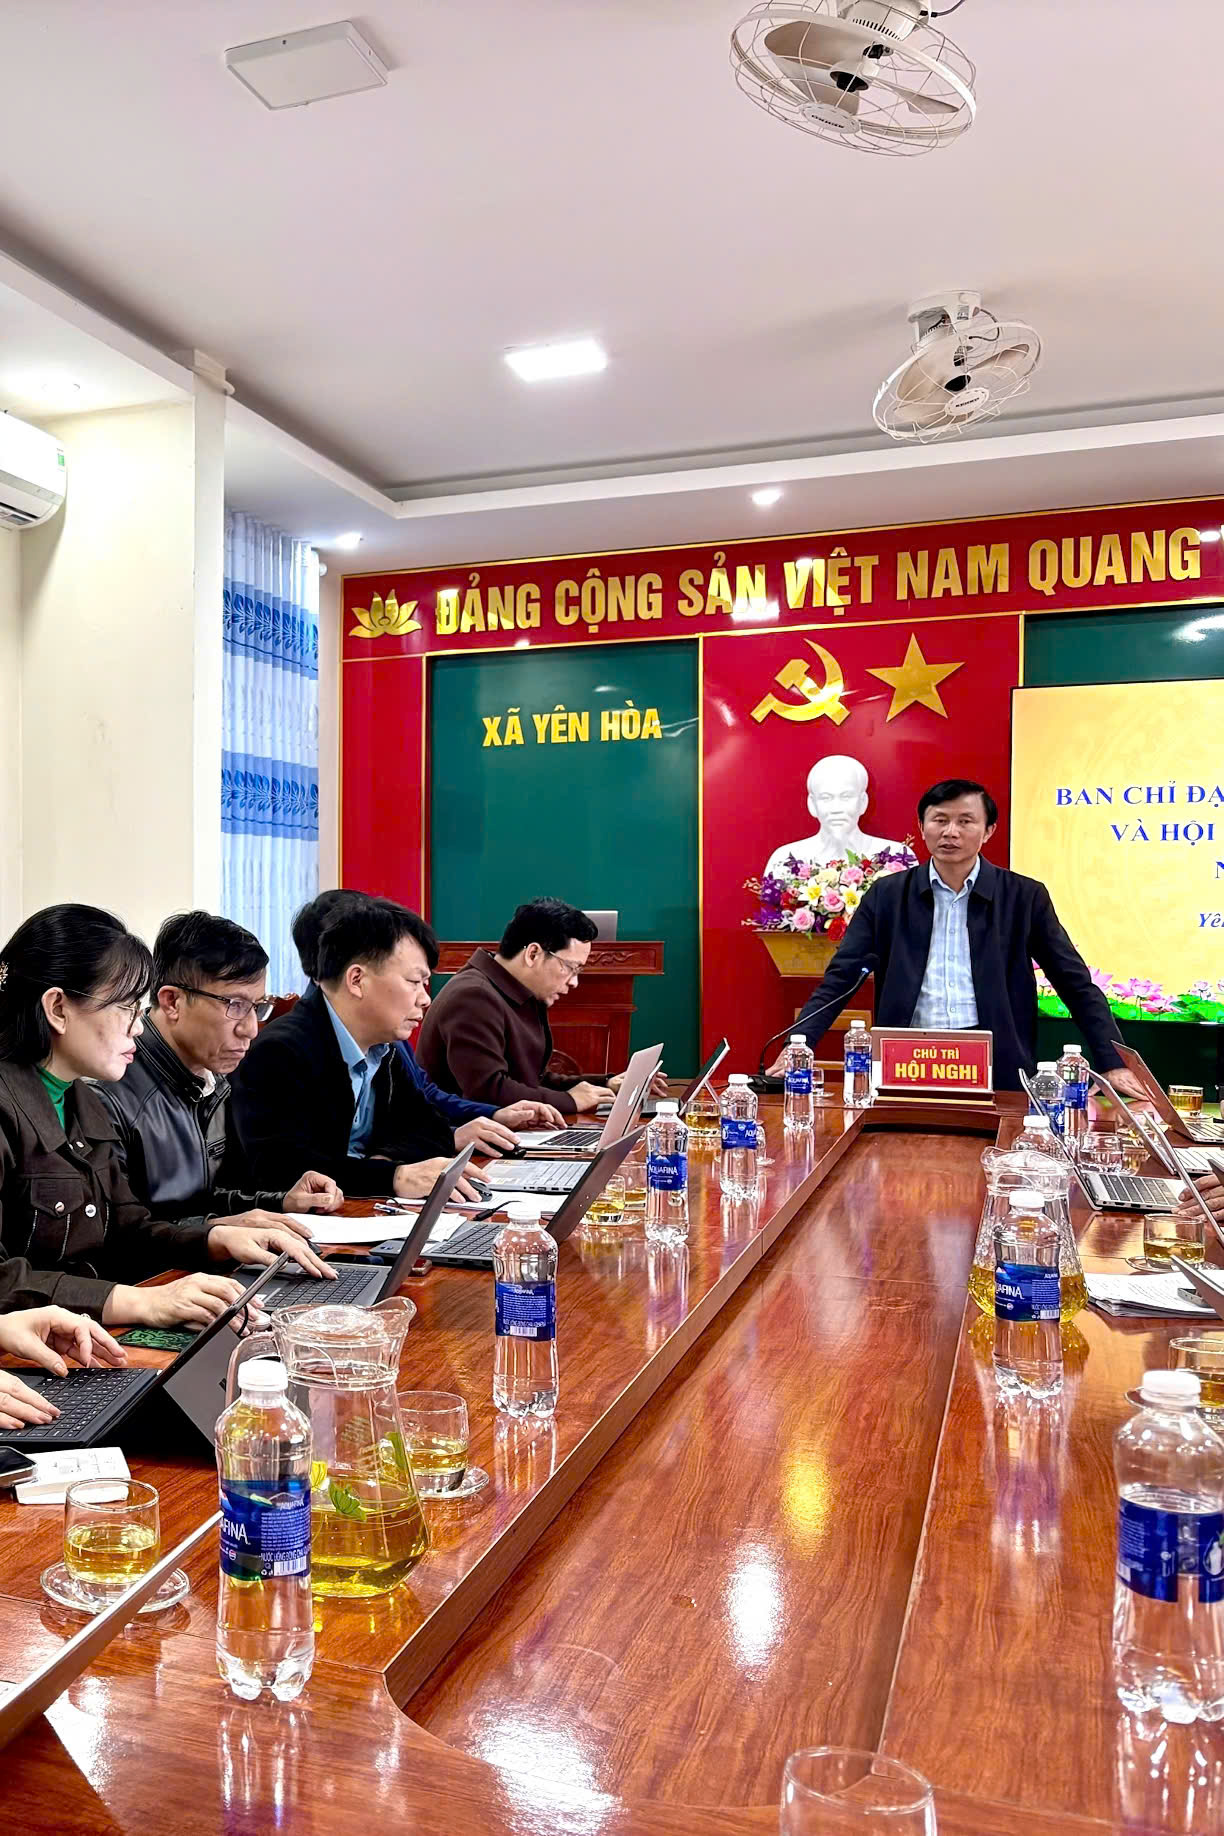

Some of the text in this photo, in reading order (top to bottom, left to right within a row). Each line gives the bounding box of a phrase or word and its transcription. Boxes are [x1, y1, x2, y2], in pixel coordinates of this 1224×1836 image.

[435, 572, 541, 635] ĐẢNG
[554, 567, 663, 634] CỘNG
[677, 551, 768, 619] SẢN
[783, 546, 879, 616] VIỆT
[896, 542, 1010, 601] NAM
[1028, 526, 1201, 597] QUANG
[482, 699, 663, 747] XÃ YÊN HÒA
[1056, 787, 1114, 806] BAN
[1123, 780, 1177, 805] CHỈ
[1110, 818, 1215, 846] VÀ HỘI
[1198, 912, 1224, 928] Yê
[913, 1046, 960, 1060] CHỦ TRÌ
[895, 1060, 978, 1084] HỘI NGHỊ
